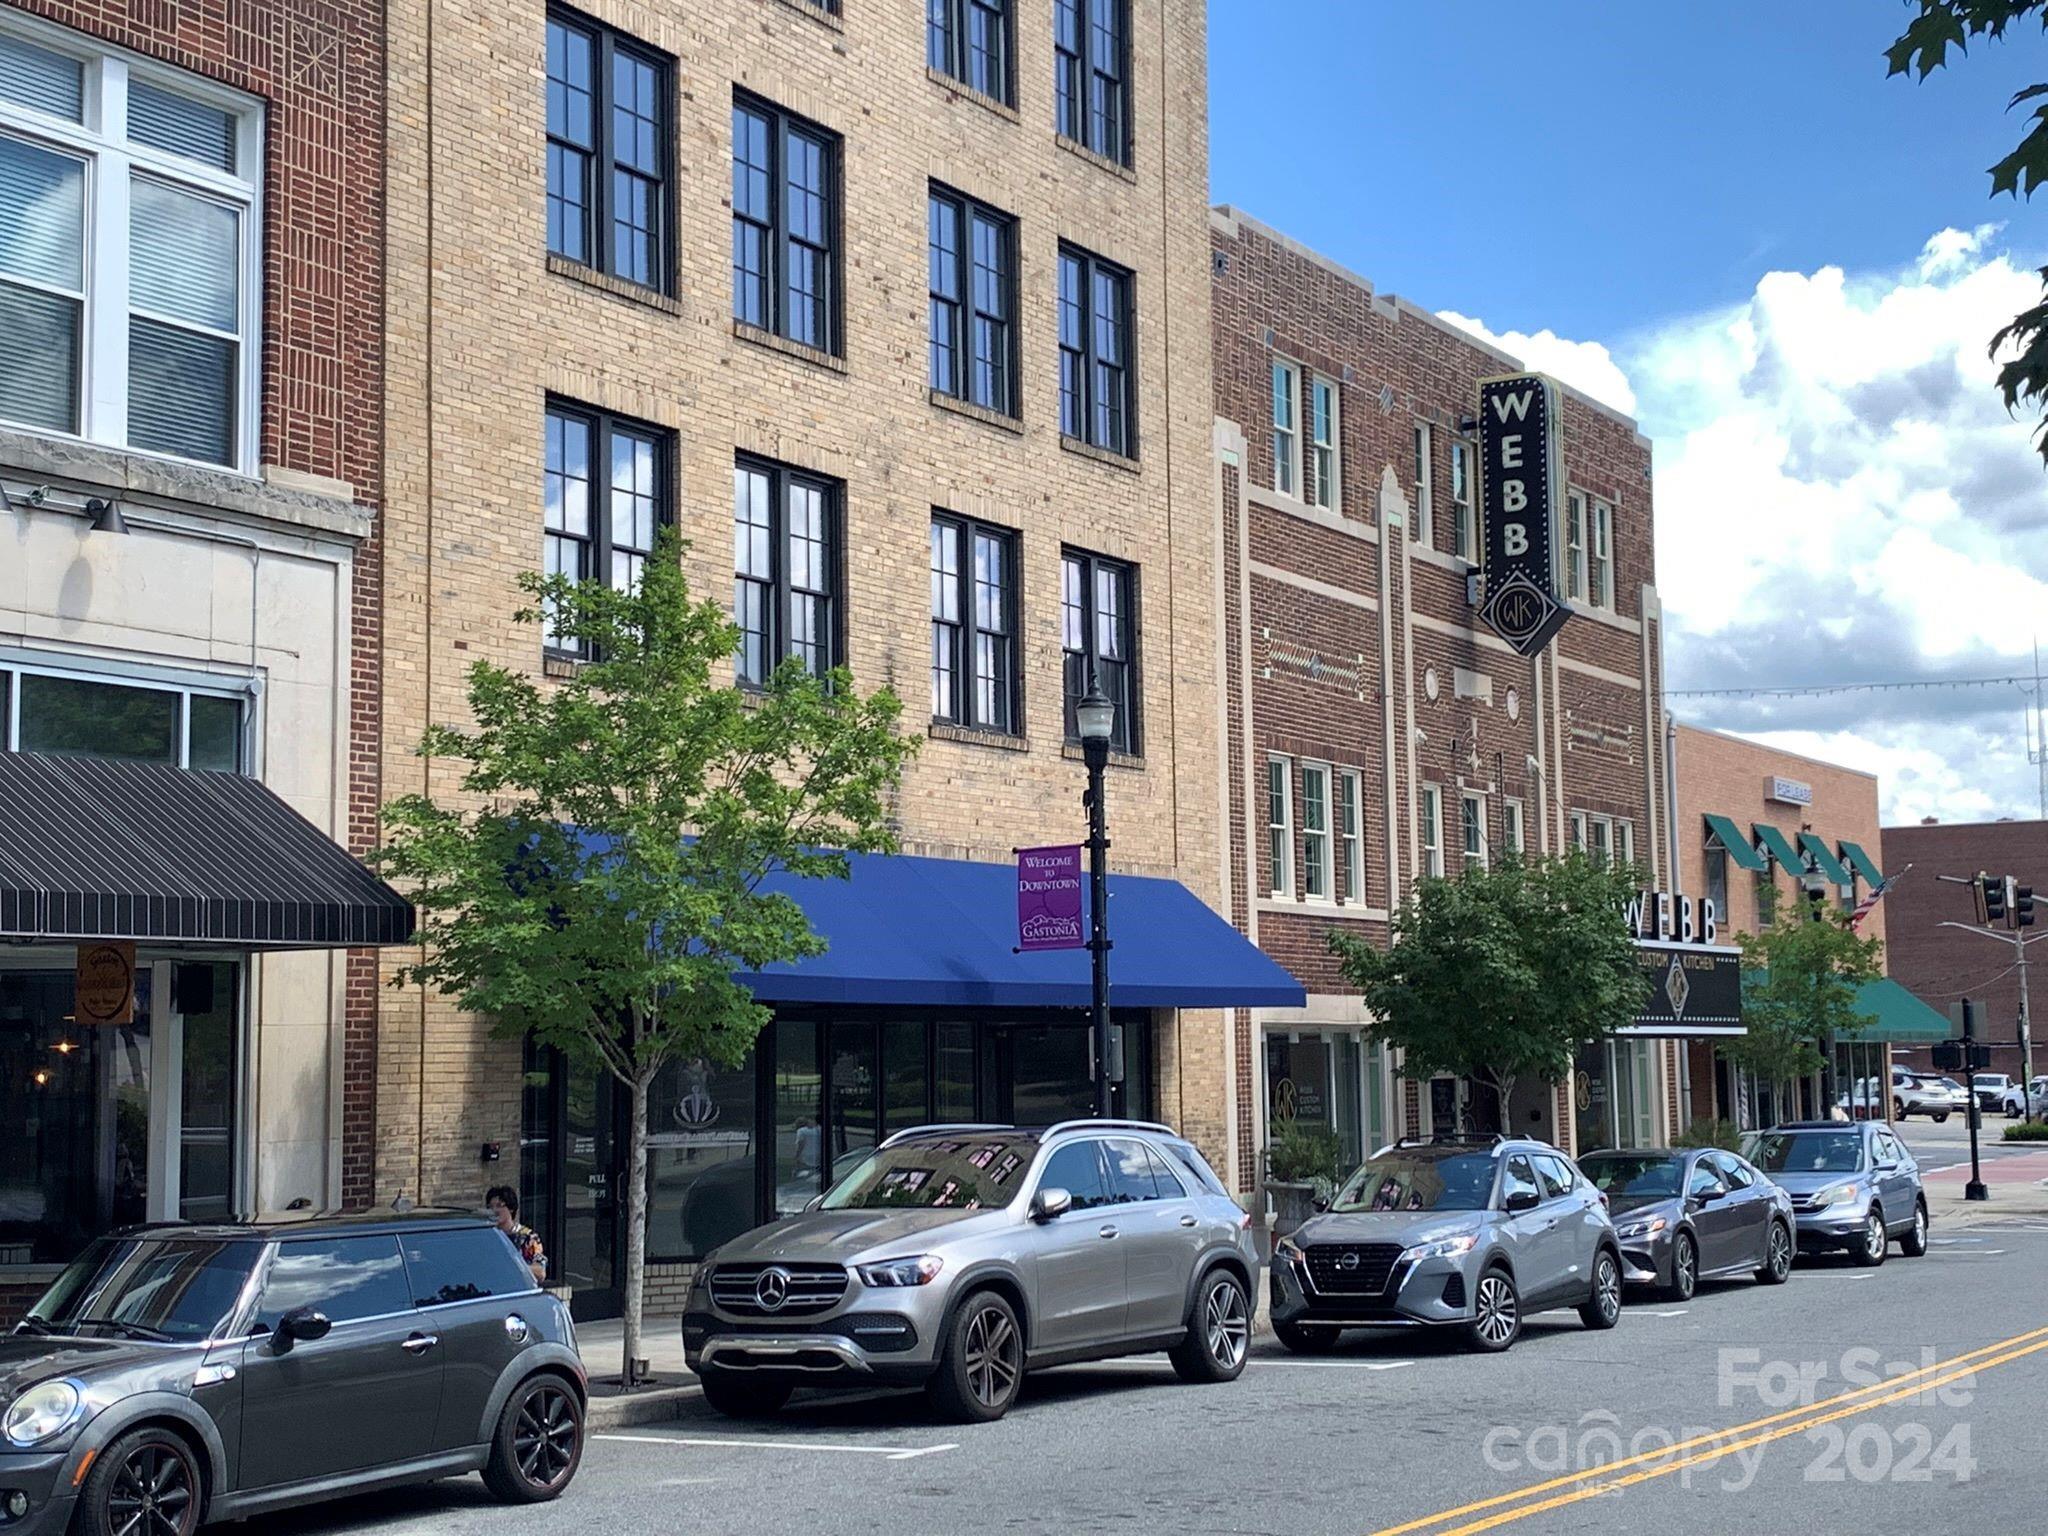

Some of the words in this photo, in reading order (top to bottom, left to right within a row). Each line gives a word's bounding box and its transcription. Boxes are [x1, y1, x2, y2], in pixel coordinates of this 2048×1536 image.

[1491, 390, 1533, 557] WEBB
[1026, 856, 1073, 868] WELCOME
[1044, 870, 1055, 878] TO
[1020, 879, 1079, 892] DOWNTOWN
[1622, 890, 1716, 945] WEBB
[1023, 922, 1079, 938] GASTONIA
[1637, 951, 1669, 967] CUSTOM
[1683, 955, 1715, 970] KITCHEN
